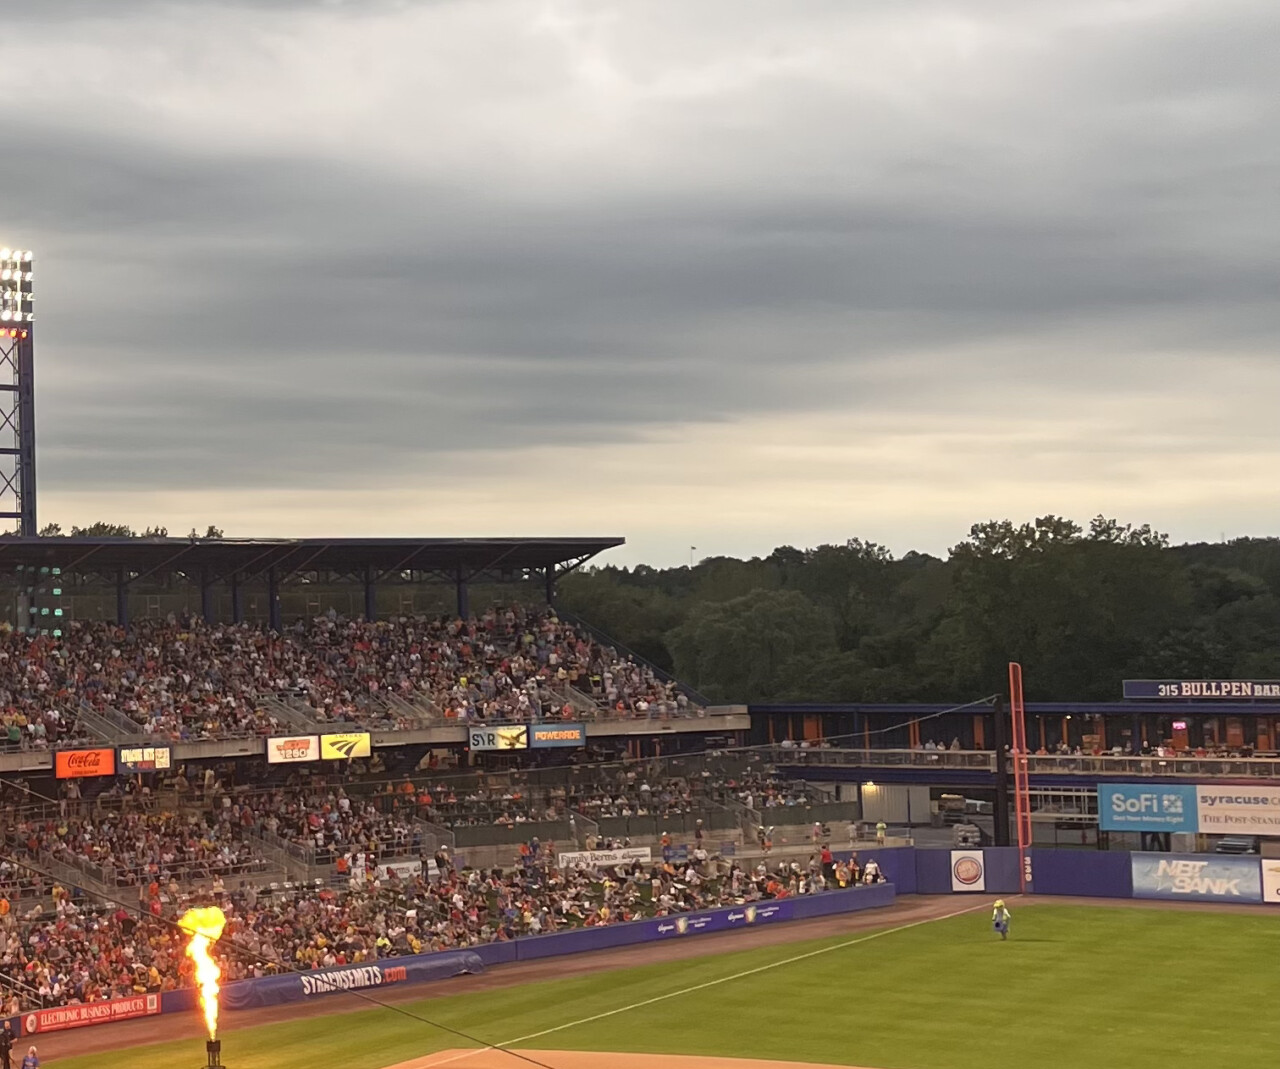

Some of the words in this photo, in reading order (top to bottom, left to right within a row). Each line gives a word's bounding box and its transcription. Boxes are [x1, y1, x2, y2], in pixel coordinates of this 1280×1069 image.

[1158, 684, 1179, 696] 315
[1181, 682, 1252, 696] BULLPEN
[1253, 685, 1280, 697] BAR
[534, 730, 581, 740] POWERADE
[68, 752, 101, 768] Coca-Cola
[1112, 793, 1158, 813] SoFi
[1200, 795, 1280, 806] syracuse.c
[1202, 814, 1223, 824] THE
[560, 854, 589, 864] Family
[1156, 860, 1208, 876] NBT
[1172, 877, 1240, 895] BANK
[40, 1008, 80, 1026] ELECTRONIC
[80, 1004, 111, 1020] BUSINESS
[111, 998, 144, 1015] PRODUCTS
